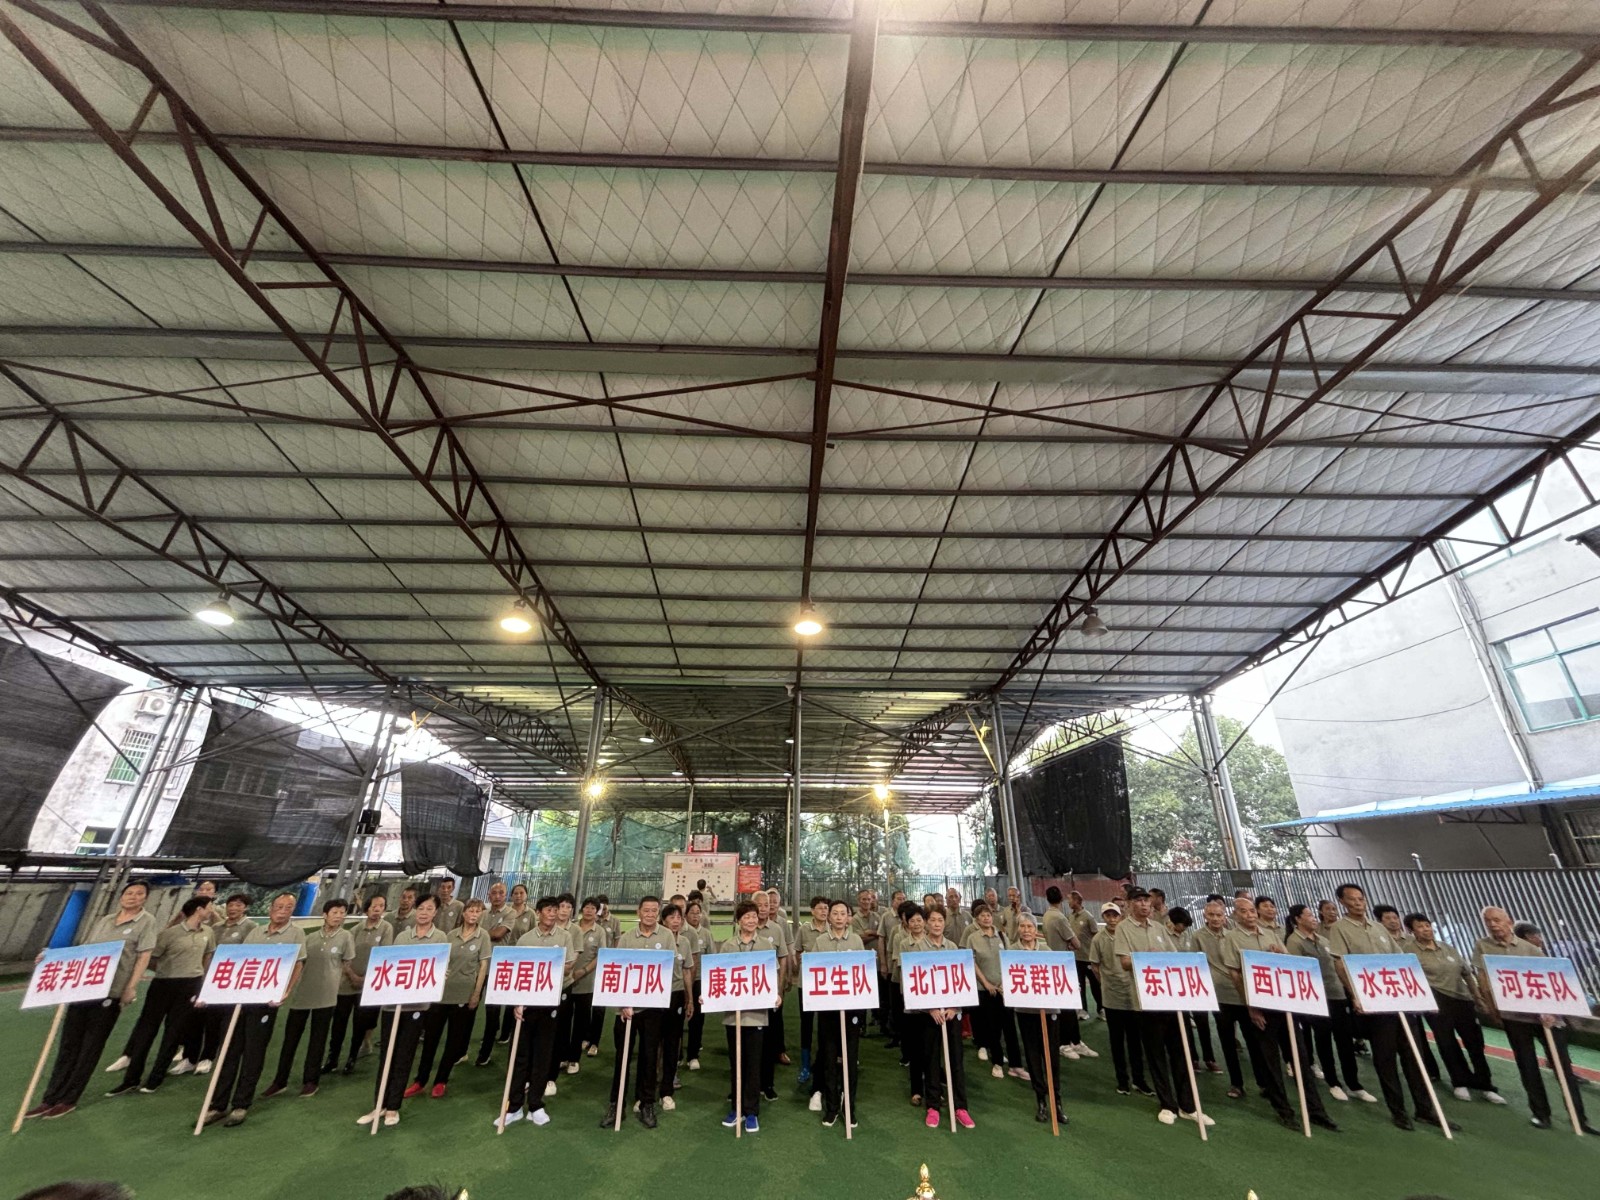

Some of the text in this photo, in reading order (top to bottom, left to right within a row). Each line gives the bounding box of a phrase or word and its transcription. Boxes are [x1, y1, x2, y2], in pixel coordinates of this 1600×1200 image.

[37, 956, 111, 992] 裁判组
[212, 958, 280, 990] 电信队
[371, 957, 437, 991] 水司队
[494, 960, 553, 992] 南居队
[601, 962, 664, 994] 南门队
[708, 964, 771, 998] 康乐队
[809, 964, 872, 996] 卫生队
[909, 963, 971, 996] 北门队
[1008, 964, 1073, 995] 党群队
[1141, 965, 1209, 998] 东门队
[1252, 964, 1320, 1001] 西门队
[1358, 967, 1426, 998] 水东队
[1497, 968, 1578, 1001] 河东队
